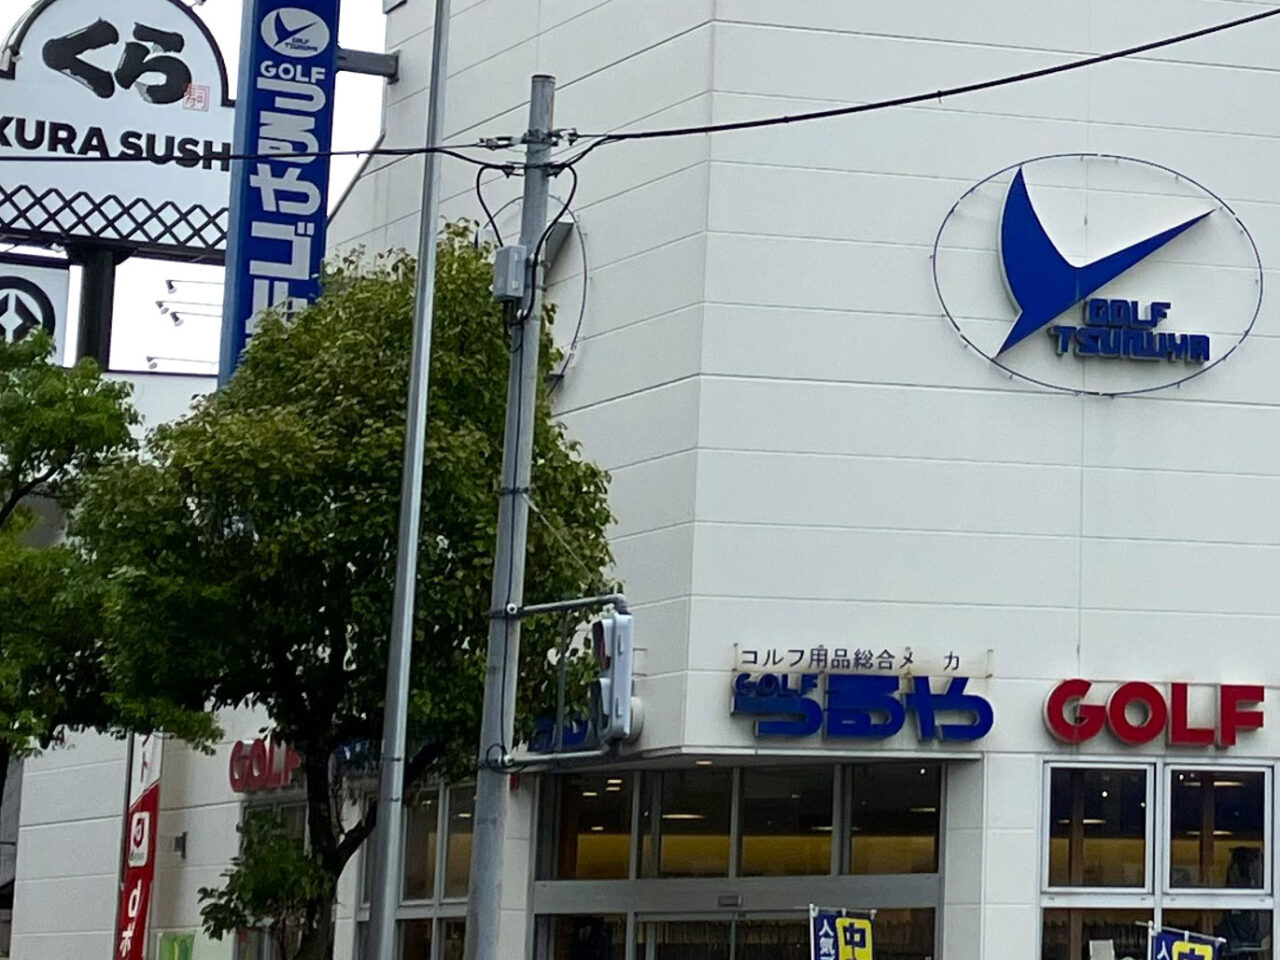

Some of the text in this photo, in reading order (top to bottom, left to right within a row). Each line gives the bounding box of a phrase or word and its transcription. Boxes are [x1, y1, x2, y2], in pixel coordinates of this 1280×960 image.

[42, 16, 192, 106] くら
[260, 60, 326, 84] GOLF
[1083, 298, 1171, 328] GOLF
[733, 673, 818, 698] GOLF
[731, 674, 994, 744] つるや
[1042, 678, 1265, 748] GOLF
[818, 919, 836, 960] 人気
[842, 922, 868, 960] 中
